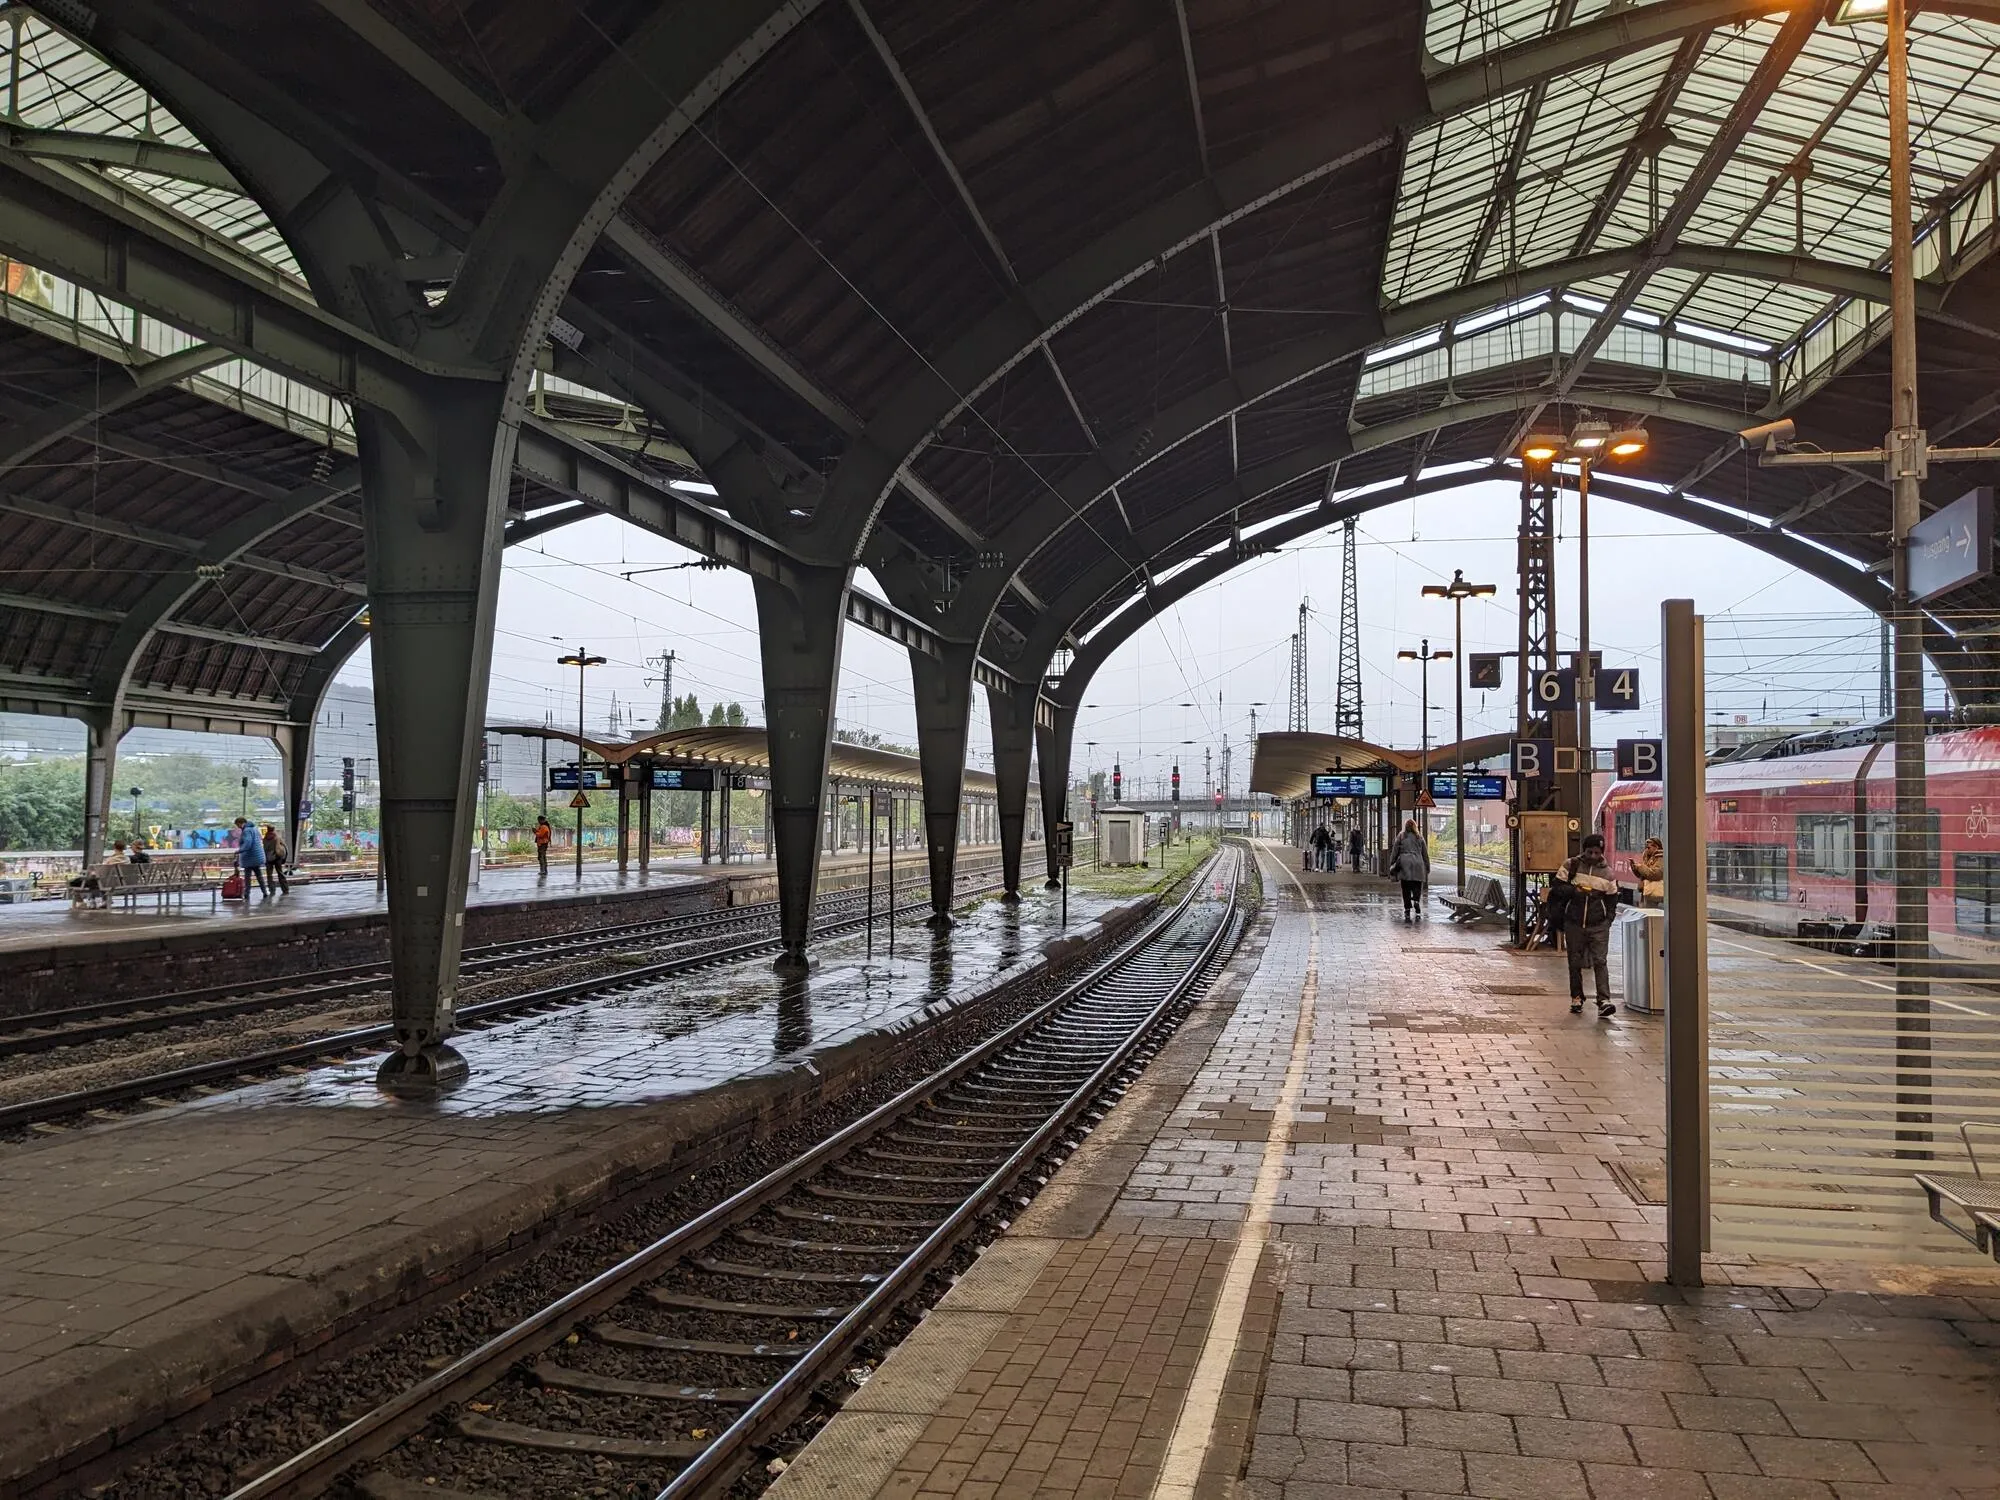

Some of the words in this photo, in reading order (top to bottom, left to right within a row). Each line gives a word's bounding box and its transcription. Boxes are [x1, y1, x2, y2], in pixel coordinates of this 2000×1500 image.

[1539, 670, 1561, 702] 6
[1612, 670, 1633, 700] 4
[1517, 743, 1540, 773] B
[1634, 743, 1657, 774] B
[737, 776, 745, 787] 8
[1058, 834, 1071, 854] H
[1159, 828, 1166, 837] H
